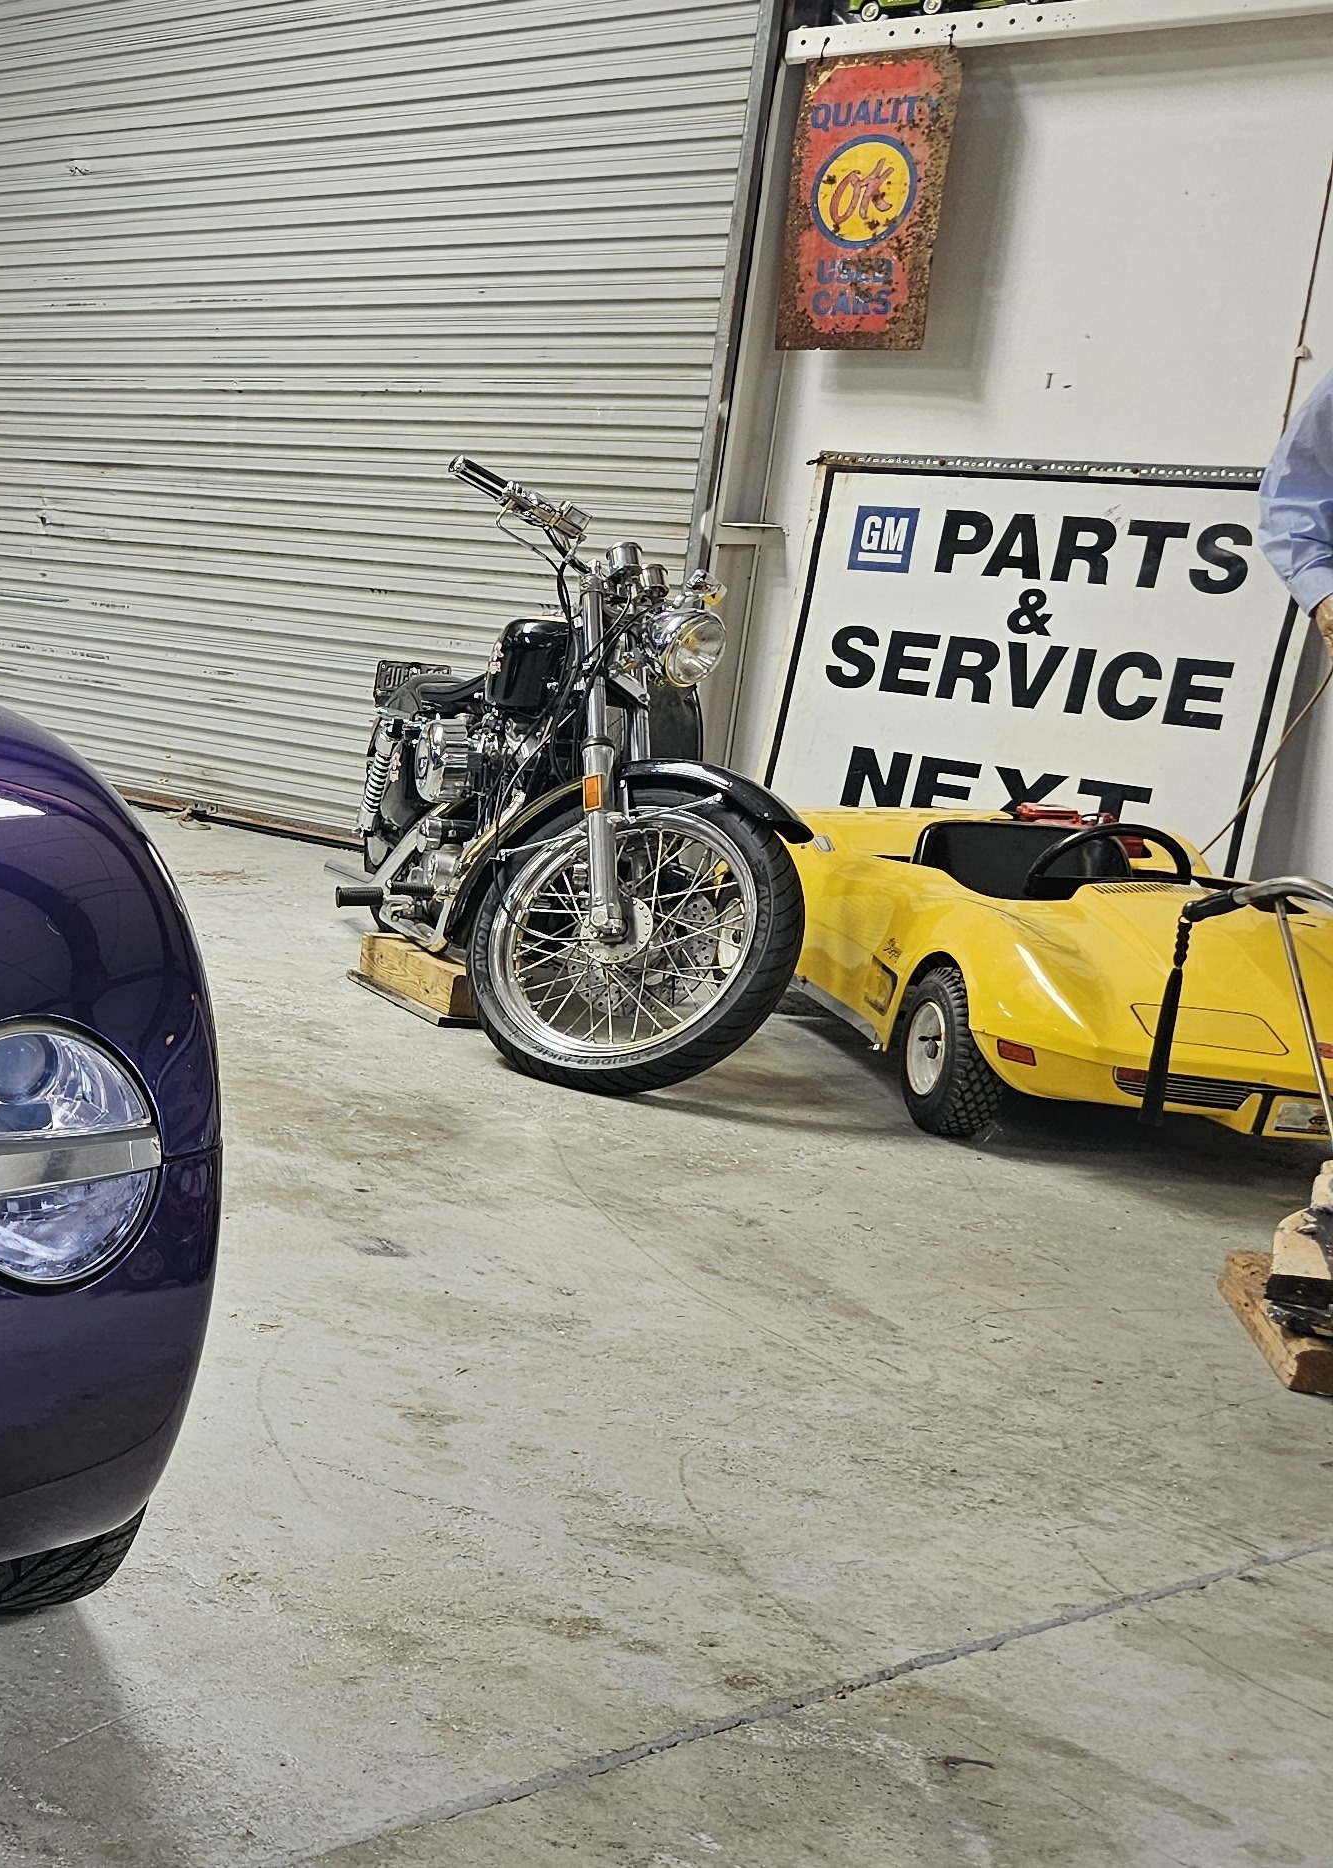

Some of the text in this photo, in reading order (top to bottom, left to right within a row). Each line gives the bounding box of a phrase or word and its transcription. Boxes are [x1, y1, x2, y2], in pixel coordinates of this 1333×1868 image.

[810, 95, 940, 132] QUALITY
[829, 158, 893, 225] OK
[812, 289, 892, 317] CARS
[860, 508, 1253, 595] GM PARTS
[1006, 588, 1053, 637] &
[824, 625, 1235, 731] SERVICE
[839, 745, 1153, 824] NEXT
[474, 911, 493, 974] AVON
[753, 884, 770, 950] AVON
